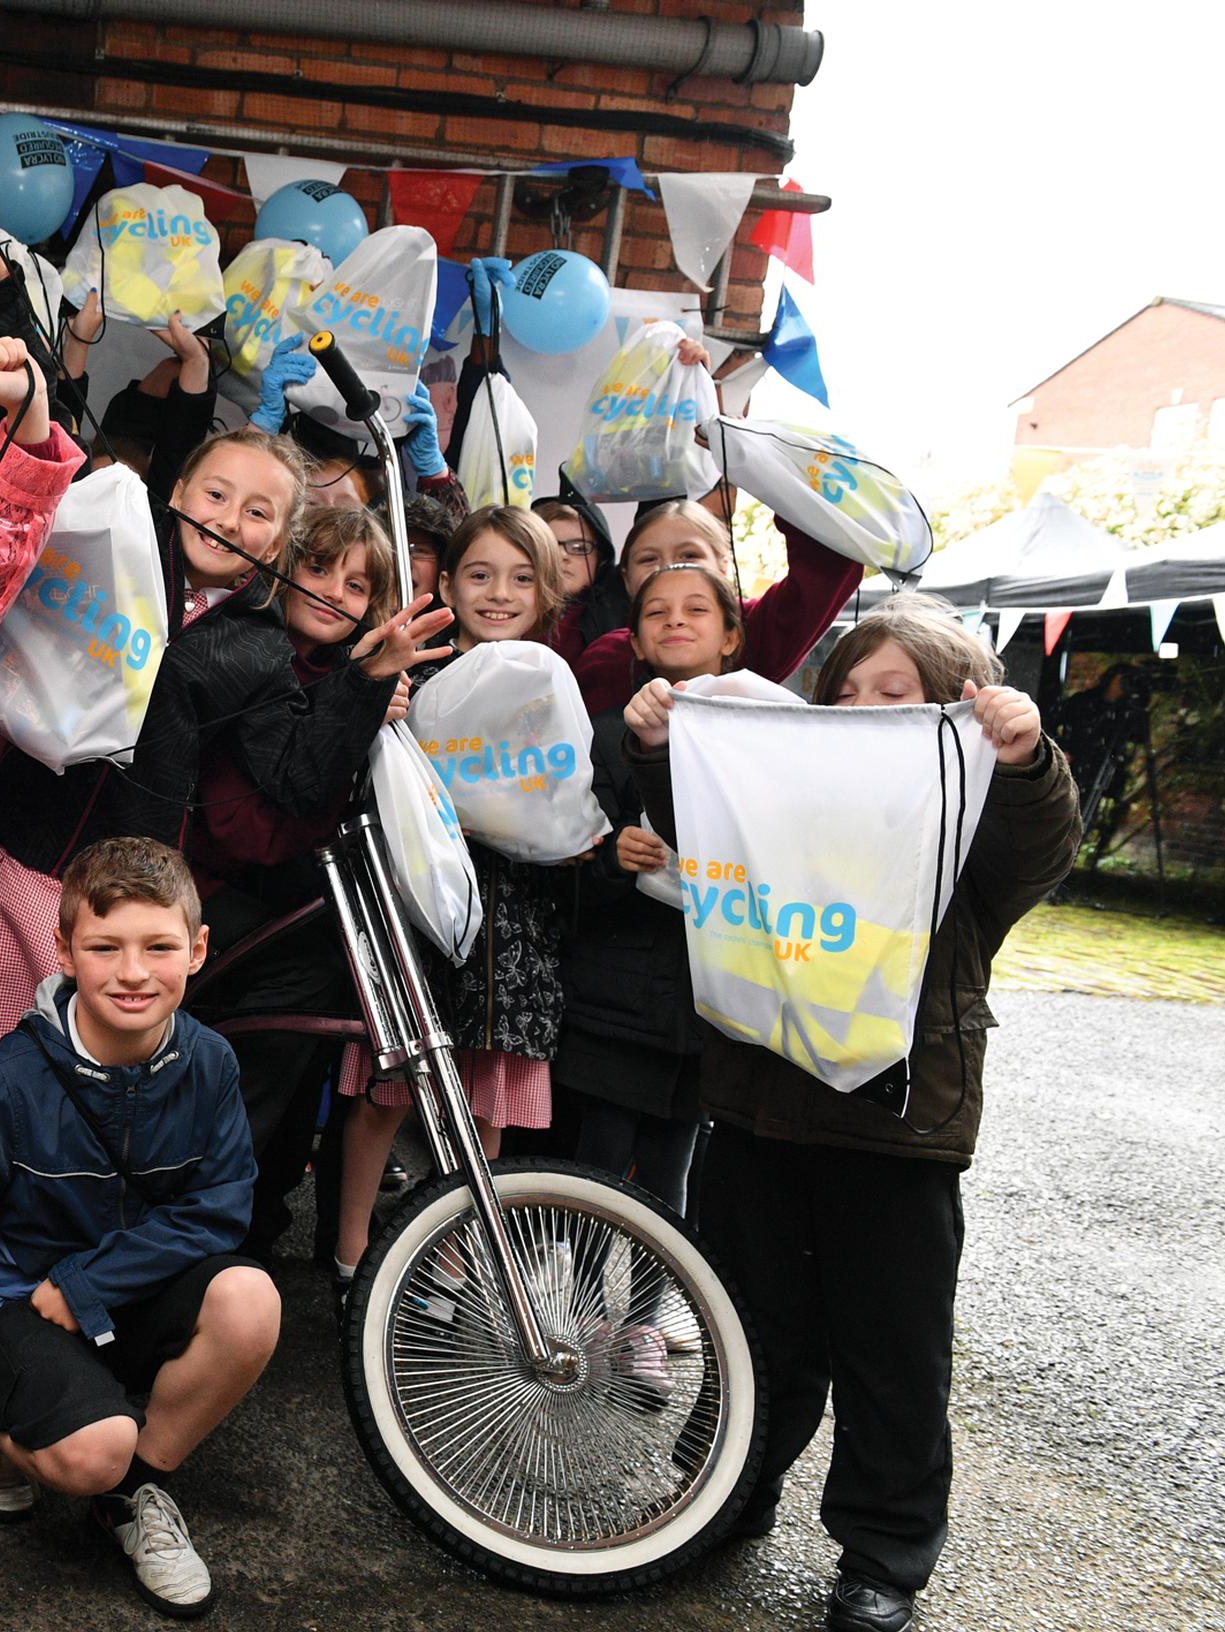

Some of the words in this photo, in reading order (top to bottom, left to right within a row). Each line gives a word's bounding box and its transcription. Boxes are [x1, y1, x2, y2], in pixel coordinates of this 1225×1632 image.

[23, 153, 53, 166] LYCRA
[170, 236, 192, 248] UK
[533, 268, 554, 297] LYCRA
[350, 290, 380, 308] are
[87, 641, 120, 669] UK
[446, 737, 482, 753] are
[431, 740, 577, 789] ycling
[520, 776, 548, 793] UK
[706, 860, 746, 883] are
[775, 940, 812, 962] UK
